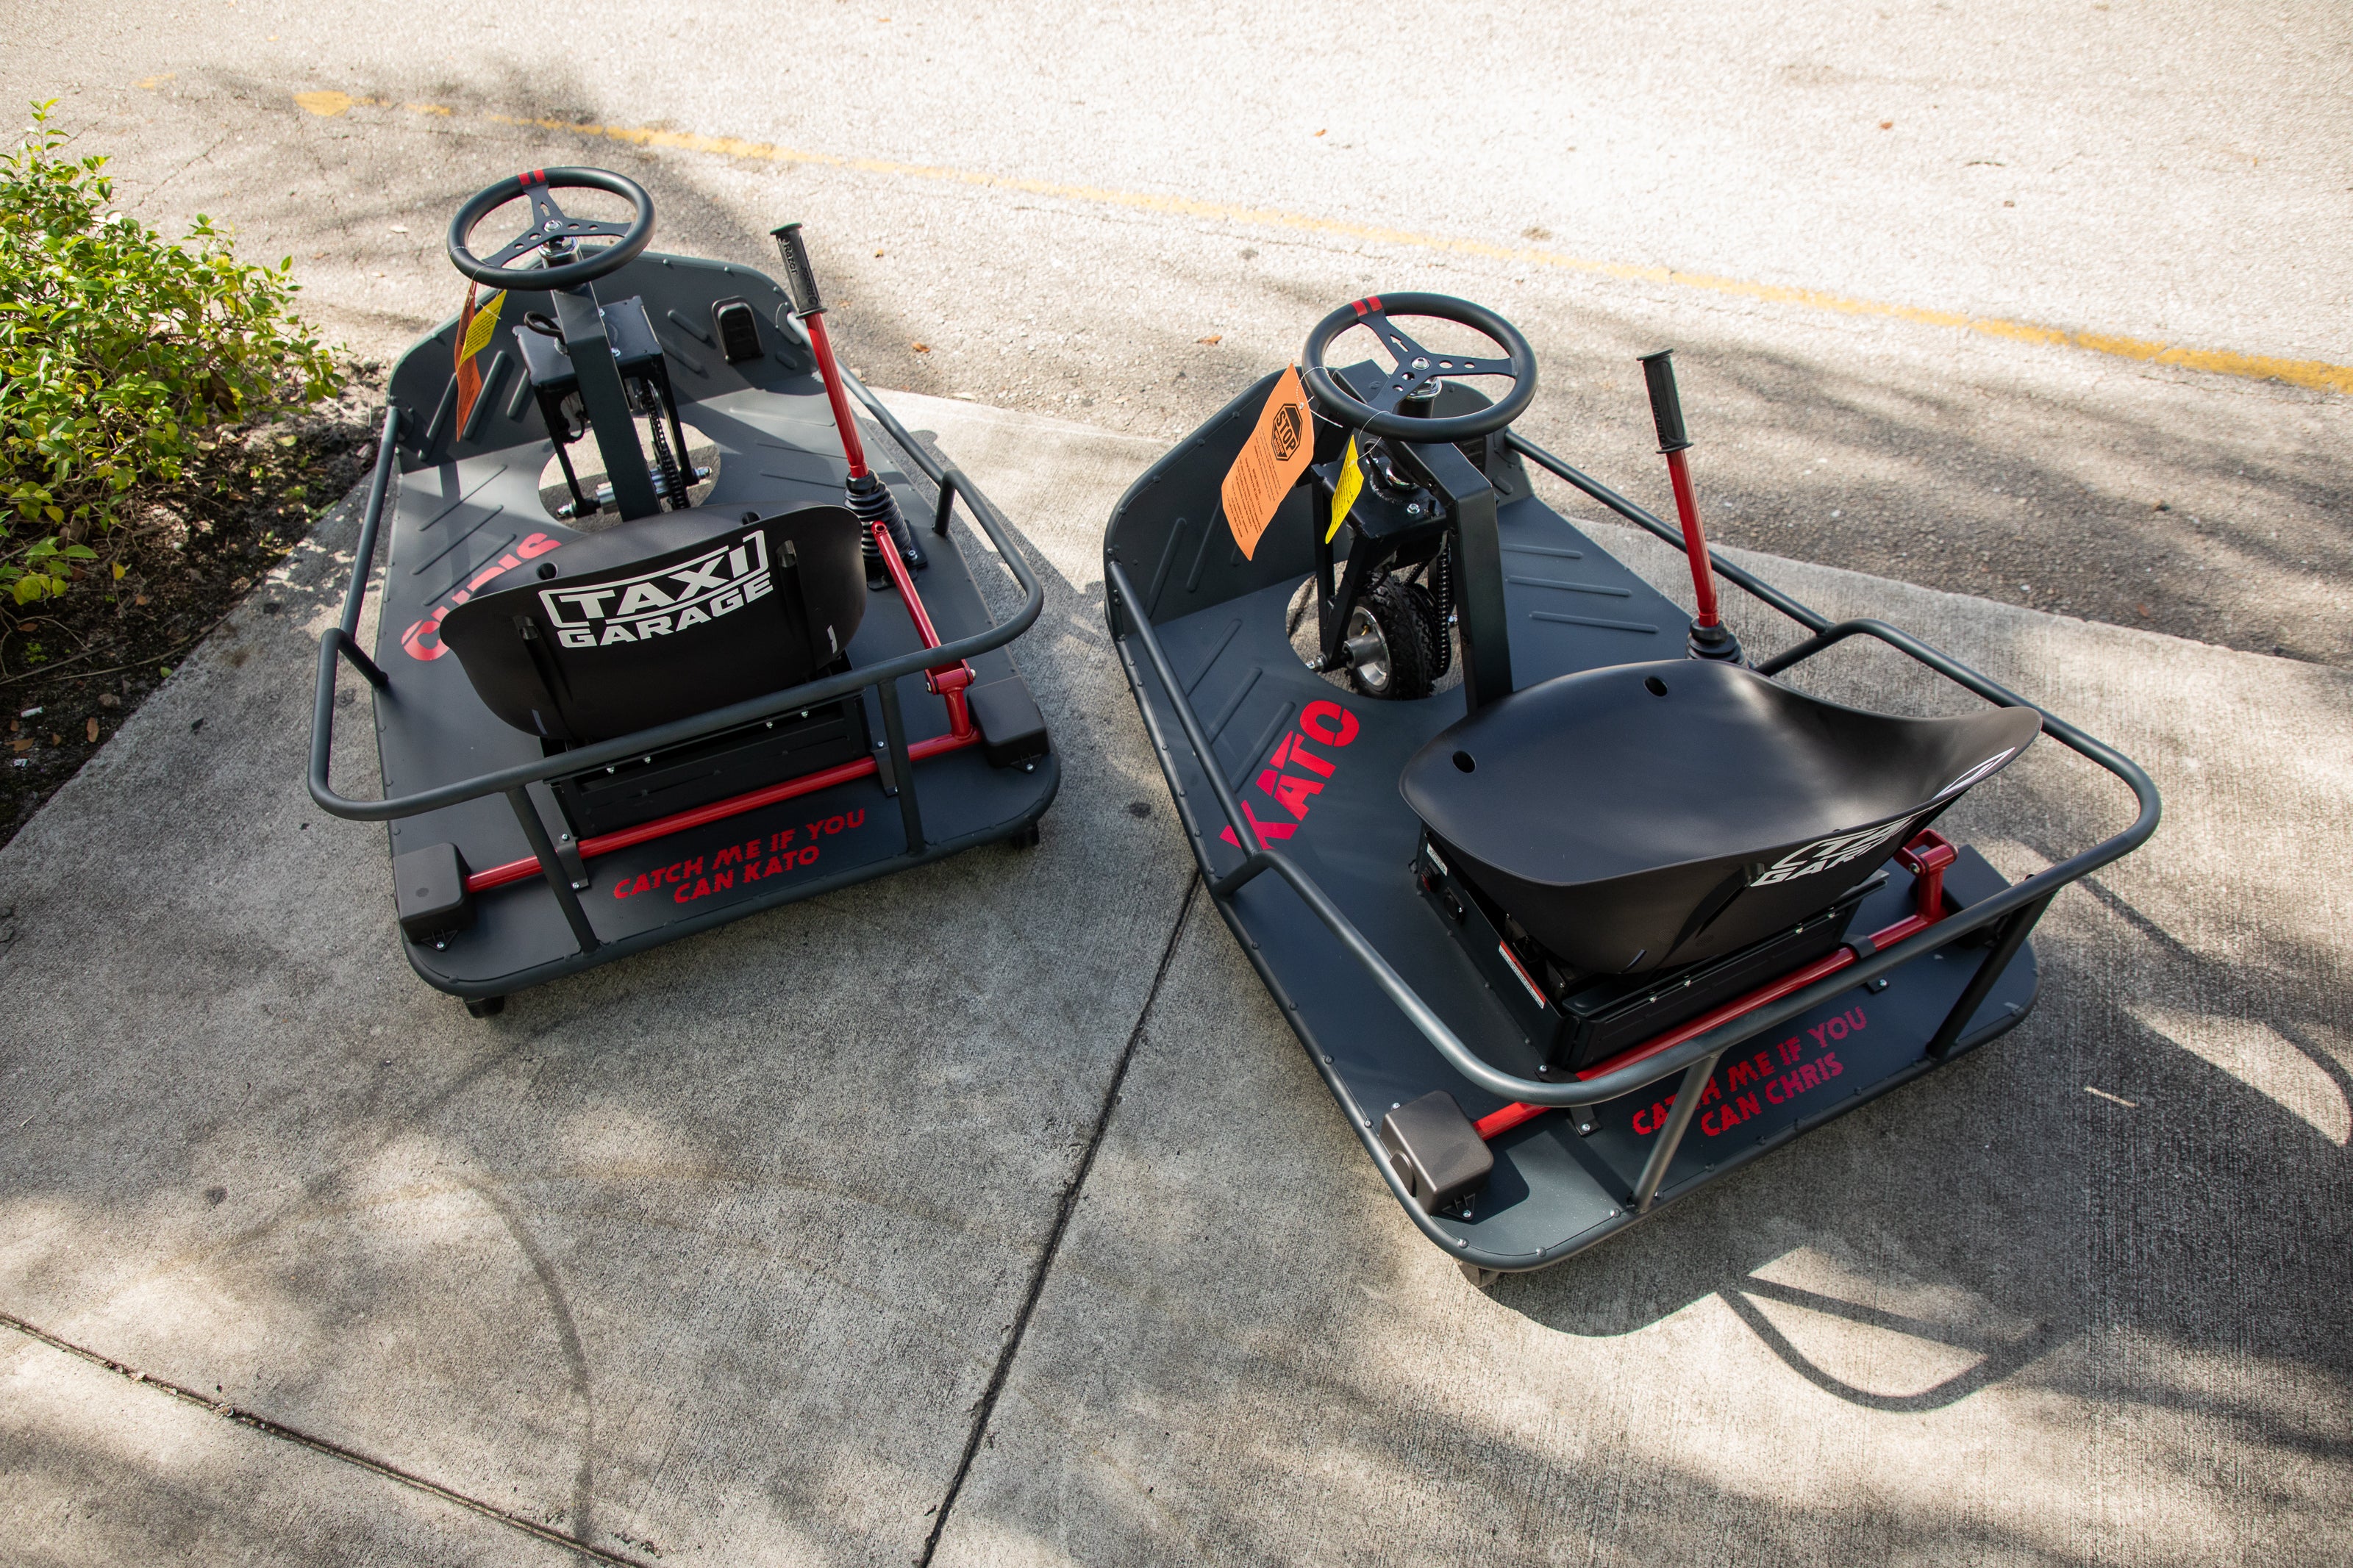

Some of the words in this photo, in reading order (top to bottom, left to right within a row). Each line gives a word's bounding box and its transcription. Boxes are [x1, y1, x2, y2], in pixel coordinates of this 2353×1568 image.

[1277, 410, 1296, 451] STOP
[557, 572, 773, 648] GARAGE
[559, 545, 749, 618] TAXI
[1219, 700, 1360, 851] KATO
[613, 856, 703, 898] CATCH
[713, 839, 761, 870] ME
[770, 828, 796, 851] IF
[806, 809, 865, 840] YOU
[674, 870, 734, 903] CAN
[743, 845, 819, 883] KATO
[1632, 1077, 1721, 1135] CAH
[1727, 1051, 1775, 1092] ME
[1777, 1036, 1802, 1065] IF
[1807, 1006, 1867, 1048] YOU
[1701, 1092, 1762, 1136] CAN
[1765, 1052, 1843, 1104] CHRIS
